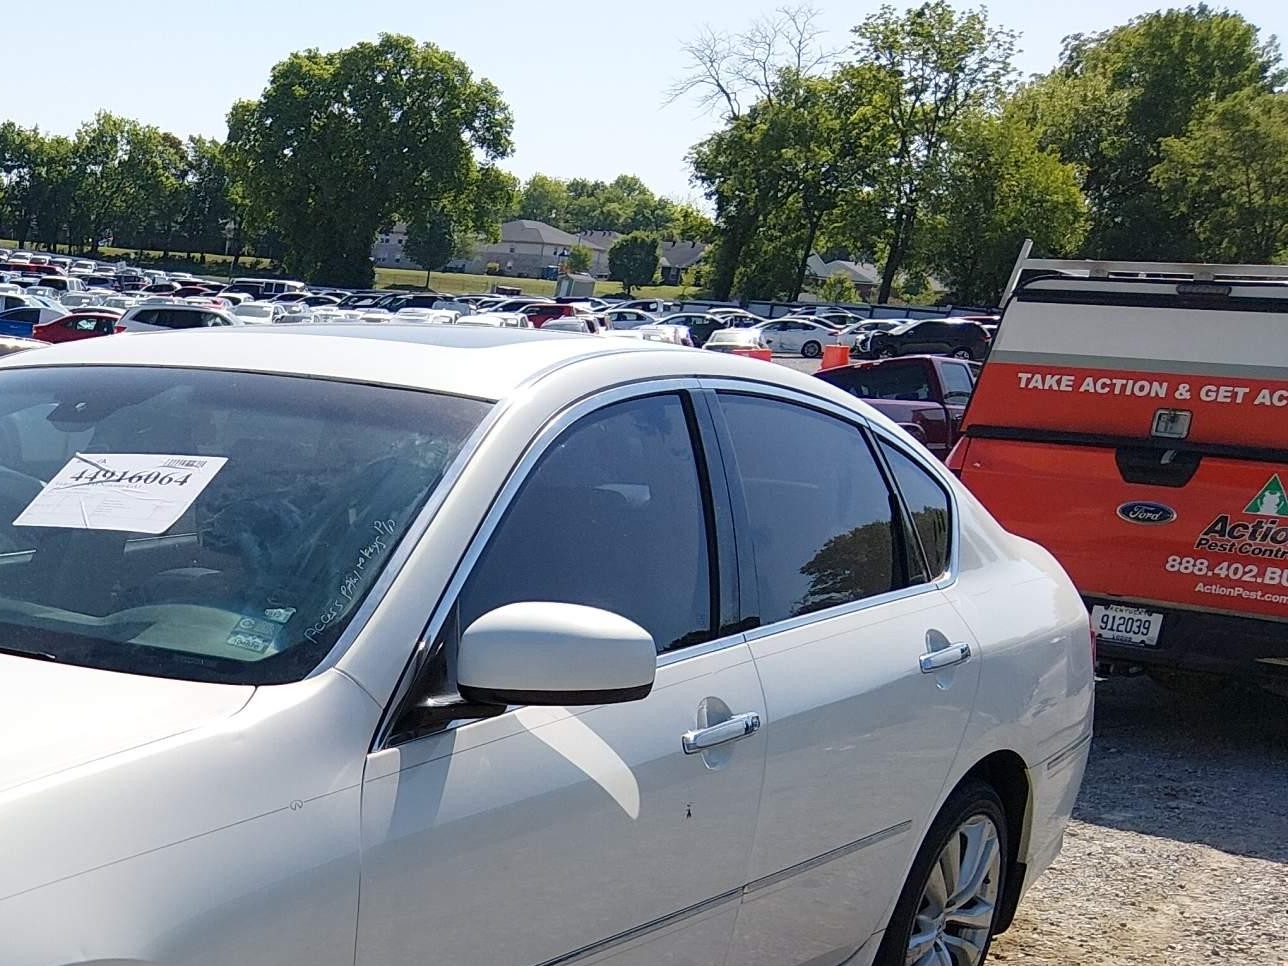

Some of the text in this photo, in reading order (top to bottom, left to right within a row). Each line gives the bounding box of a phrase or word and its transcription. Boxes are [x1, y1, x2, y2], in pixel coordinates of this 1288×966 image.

[1017, 372, 1075, 391] TAKE
[1079, 377, 1168, 398] ACTION
[1174, 383, 1192, 400] &
[1199, 385, 1249, 403] GET
[70, 468, 192, 486] 44916064
[1129, 505, 1162, 521] Ford
[1195, 537, 1237, 552] Pest
[1099, 614, 1151, 636] 912039
